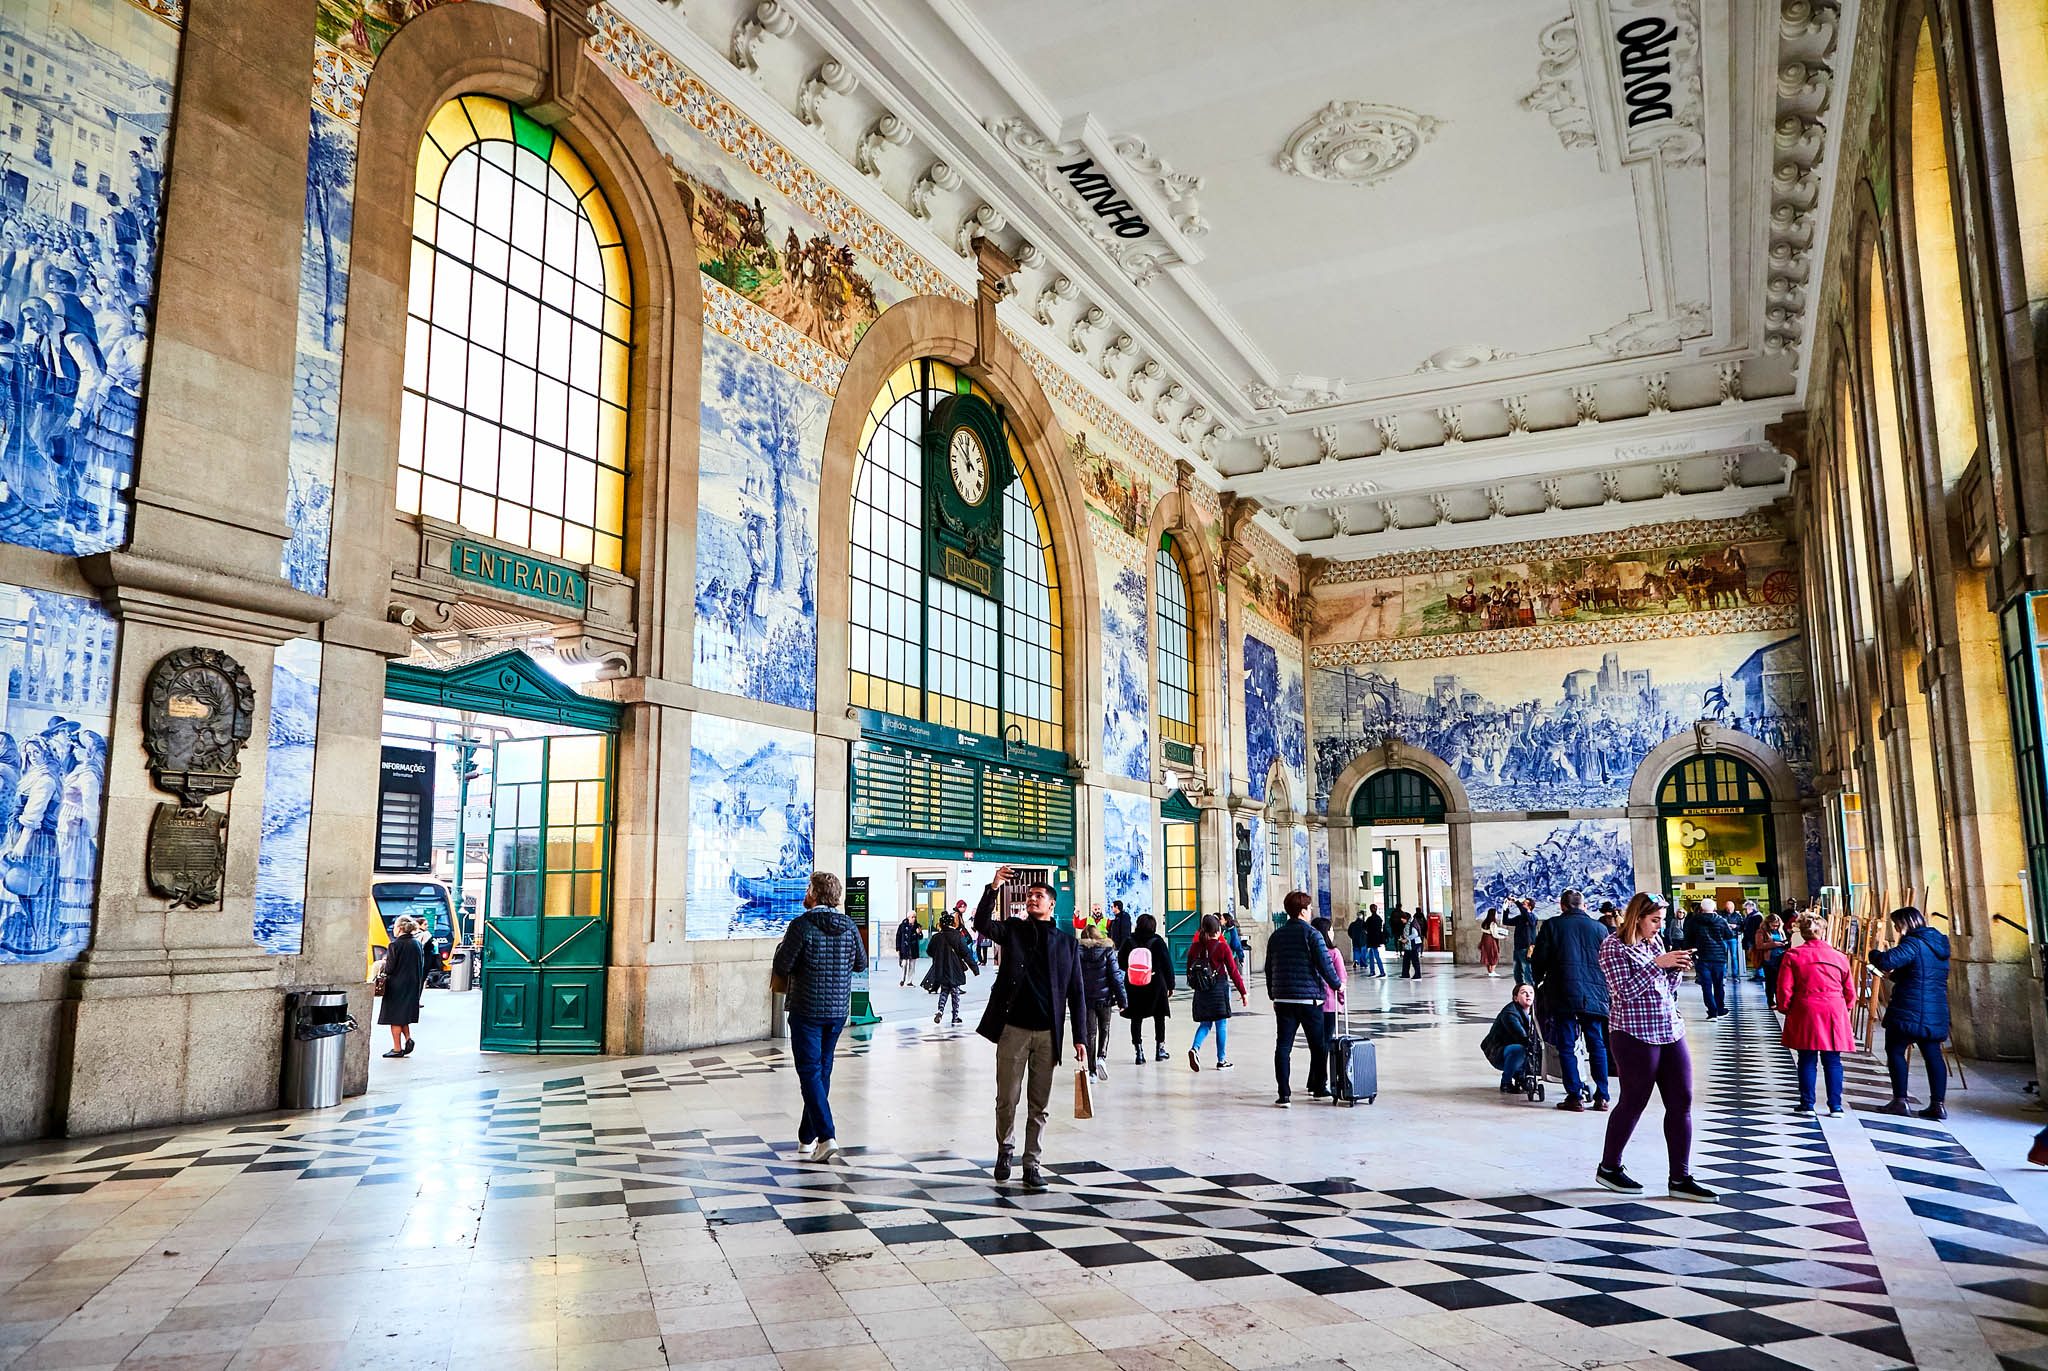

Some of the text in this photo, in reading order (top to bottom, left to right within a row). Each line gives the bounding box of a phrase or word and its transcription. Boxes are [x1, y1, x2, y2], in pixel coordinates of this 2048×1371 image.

[1617, 17, 1678, 128] DOURO
[1056, 158, 1150, 238] MINHO
[462, 547, 575, 602] ENTRADA
[953, 555, 984, 584] PORTO
[381, 761, 426, 774] INFORMAÇÕES
